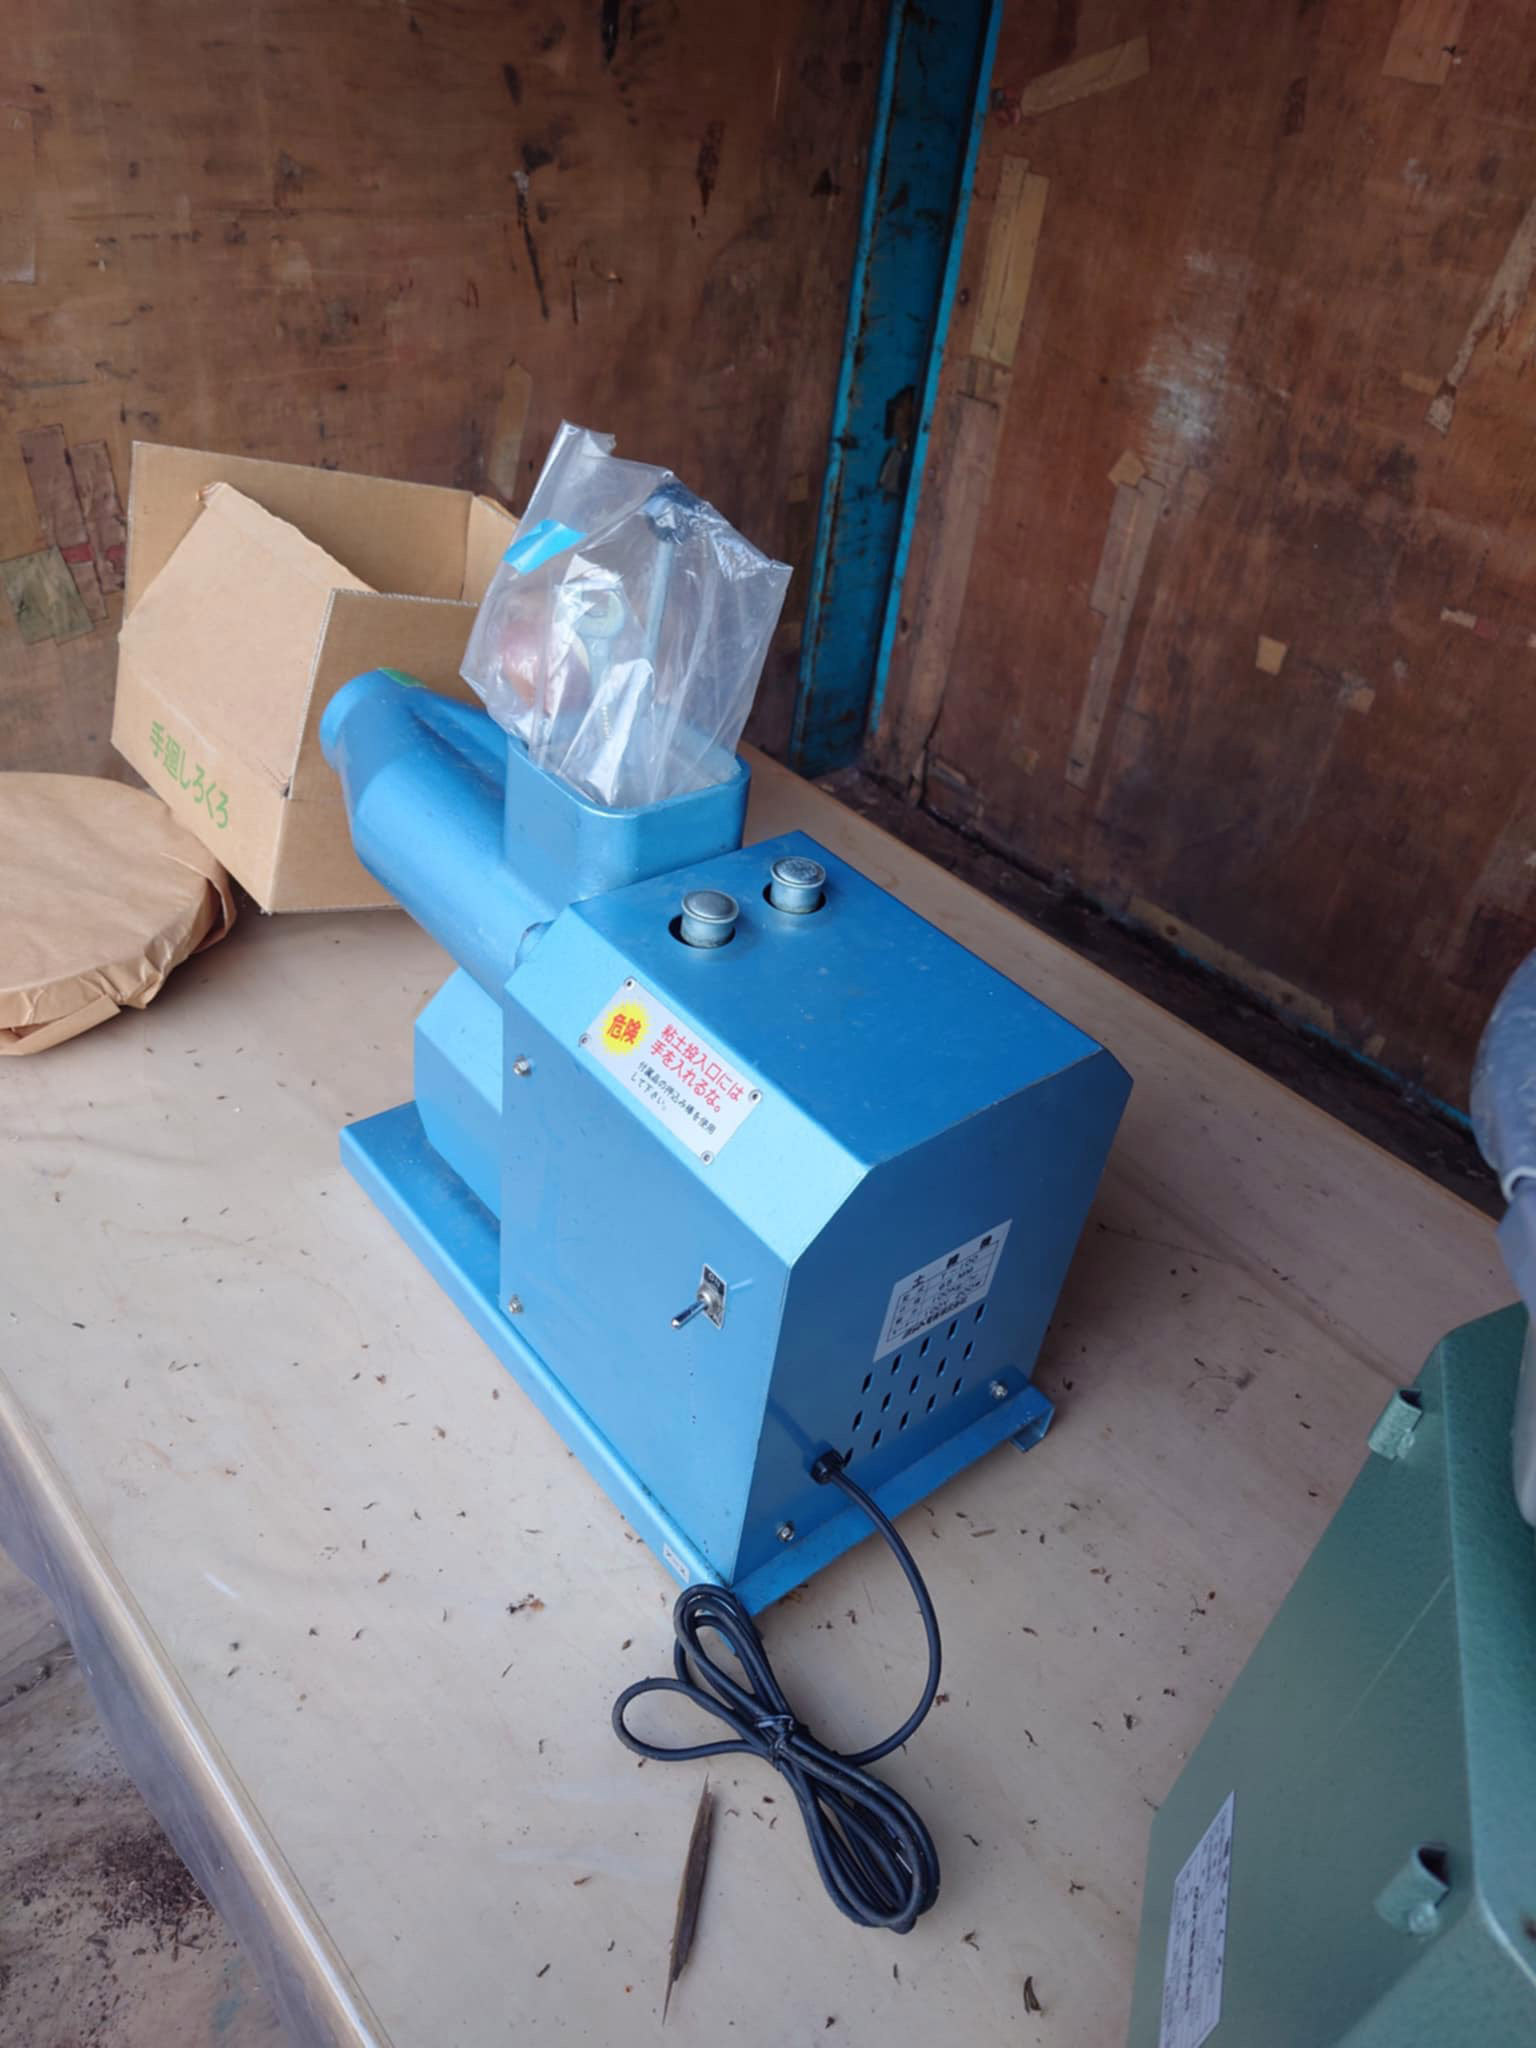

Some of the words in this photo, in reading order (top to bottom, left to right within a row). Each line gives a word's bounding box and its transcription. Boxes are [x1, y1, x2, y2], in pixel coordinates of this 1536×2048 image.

[607, 1013, 641, 1045] 危険
[661, 1024, 744, 1101] 粘土投入口には
[650, 1040, 722, 1113] 手を入れるな。
